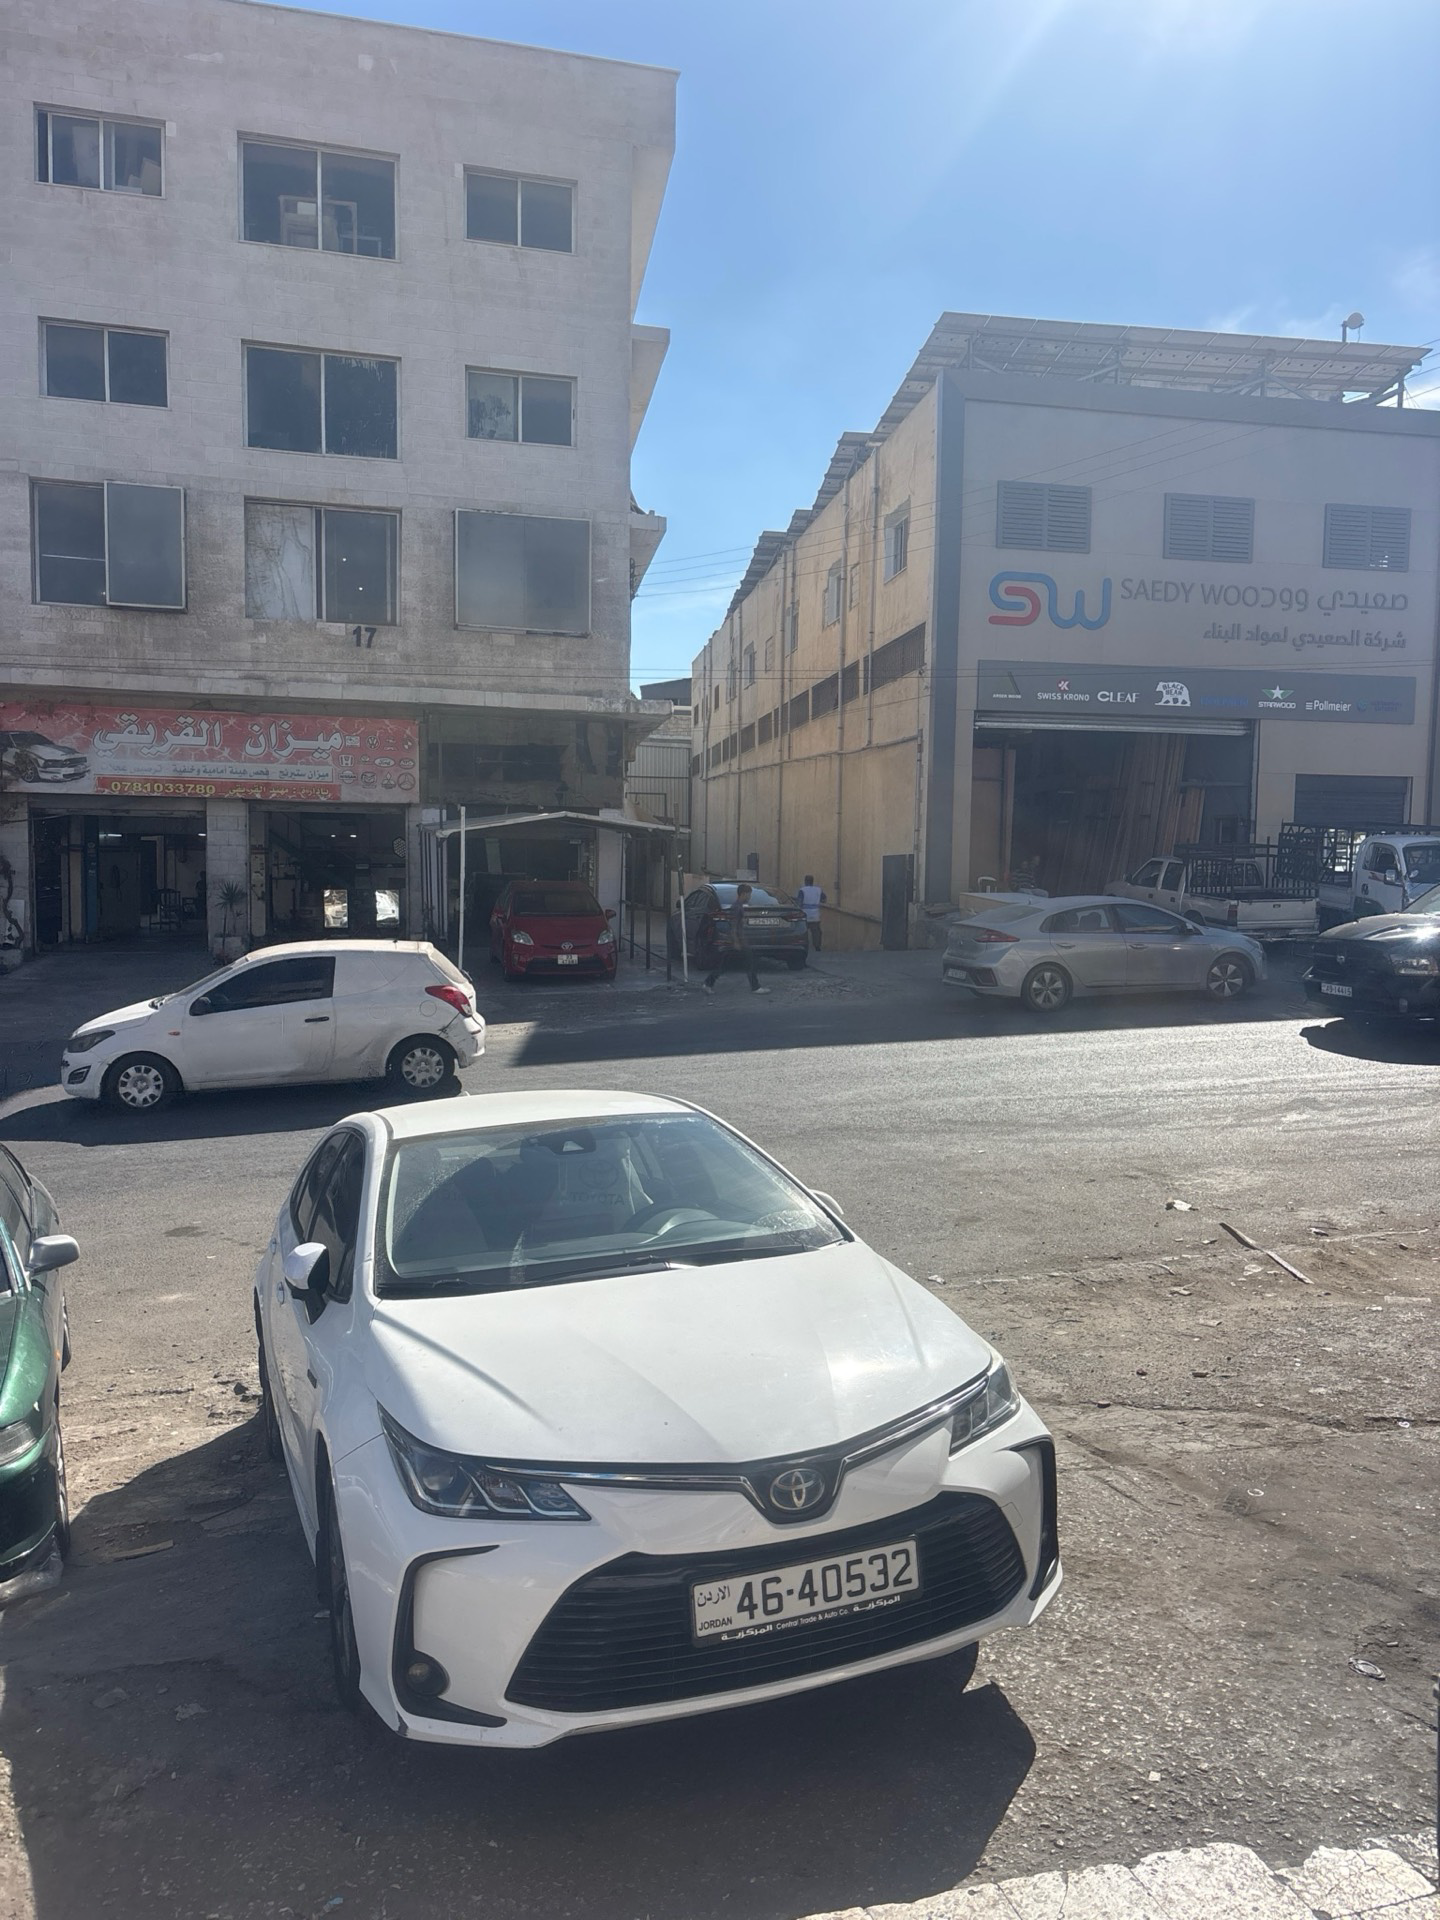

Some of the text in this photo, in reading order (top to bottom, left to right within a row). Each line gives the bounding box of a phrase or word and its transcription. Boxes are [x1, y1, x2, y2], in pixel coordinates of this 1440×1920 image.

[1120, 578, 1195, 604] SAEDY
[1317, 589, 1409, 617] صعيدي
[352, 625, 377, 649] 17
[1203, 622, 1407, 652] شركة الصعيدي لمواد البناء
[1162, 683, 1184, 691] BLACK
[1037, 692, 1090, 702] SWISS KRONO
[1097, 690, 1140, 703] CLEAF
[1258, 701, 1296, 709] STARWOOD
[1313, 700, 1352, 712] Pollmeier
[93, 712, 344, 760] ميزان القريقي
[249, 768, 270, 778] فحص
[308, 770, 329, 780] ميزان
[111, 781, 216, 795] 0781033780
[736, 1547, 914, 1621] 46-40532
[853, 1595, 901, 1612] المركزية
[698, 1616, 733, 1632] JORDAN
[776, 1618, 799, 1631] Central
[799, 1614, 818, 1626] Trade
[824, 1608, 839, 1620] Auto
[839, 1606, 850, 1617] Co.
[721, 1624, 773, 1641] المركزية
